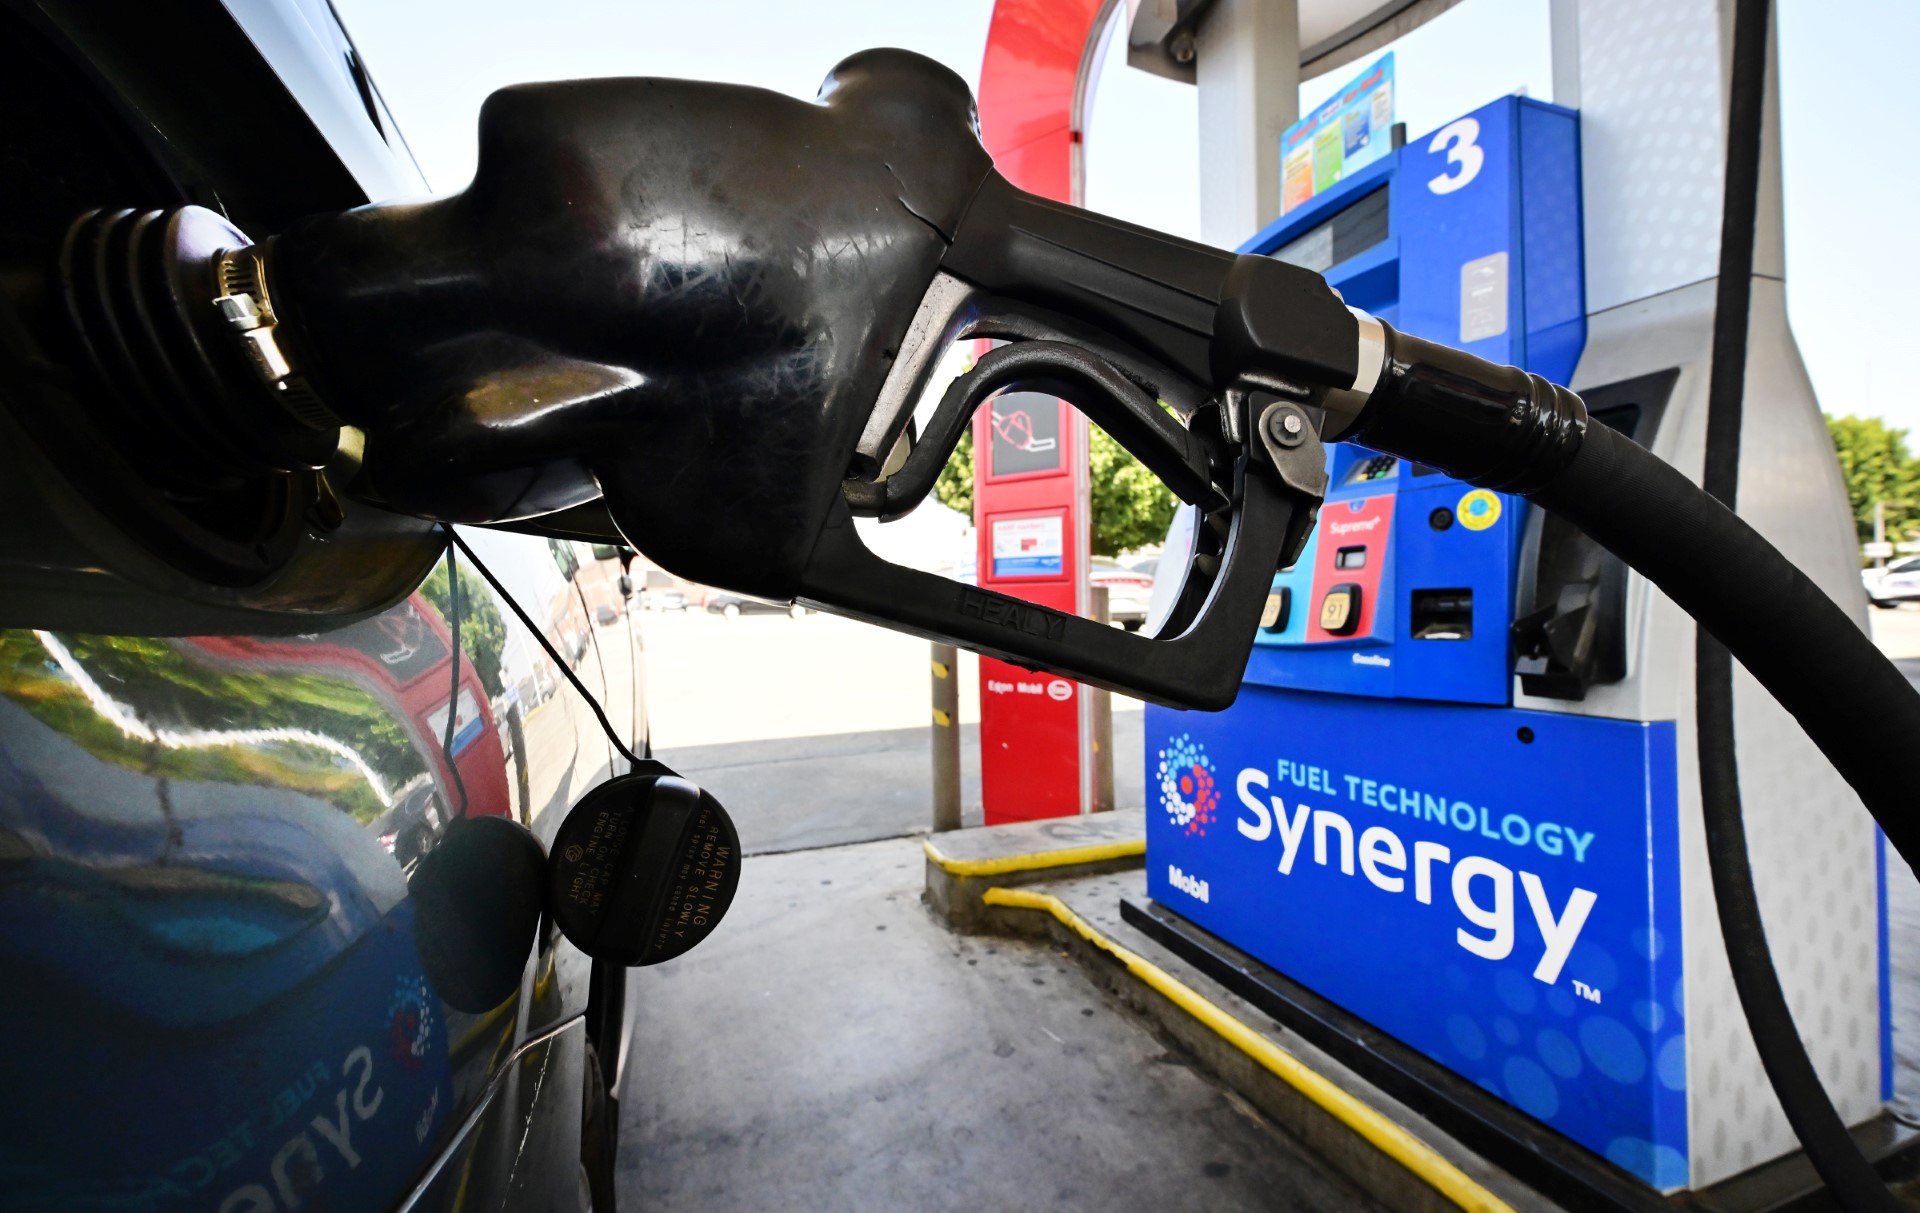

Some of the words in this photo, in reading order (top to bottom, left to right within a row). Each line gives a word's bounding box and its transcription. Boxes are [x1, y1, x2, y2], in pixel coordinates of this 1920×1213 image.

[1428, 117, 1484, 195] 3
[961, 590, 1064, 639] HEALY
[1327, 603, 1343, 618] 91
[585, 810, 609, 855] ENGINE
[603, 811, 622, 839] TURN
[1276, 758, 1337, 796] FUEL
[1344, 774, 1595, 863] TECHNOLOGY
[595, 846, 609, 861] ON
[695, 826, 719, 877] REMOVE
[569, 862, 590, 900] LIGHT
[579, 867, 600, 905] CHECK
[693, 846, 731, 926] WARNING
[1168, 864, 1210, 904] Mobil
[1236, 767, 1598, 985] Synergy
[674, 885, 699, 938] SLOWLY
